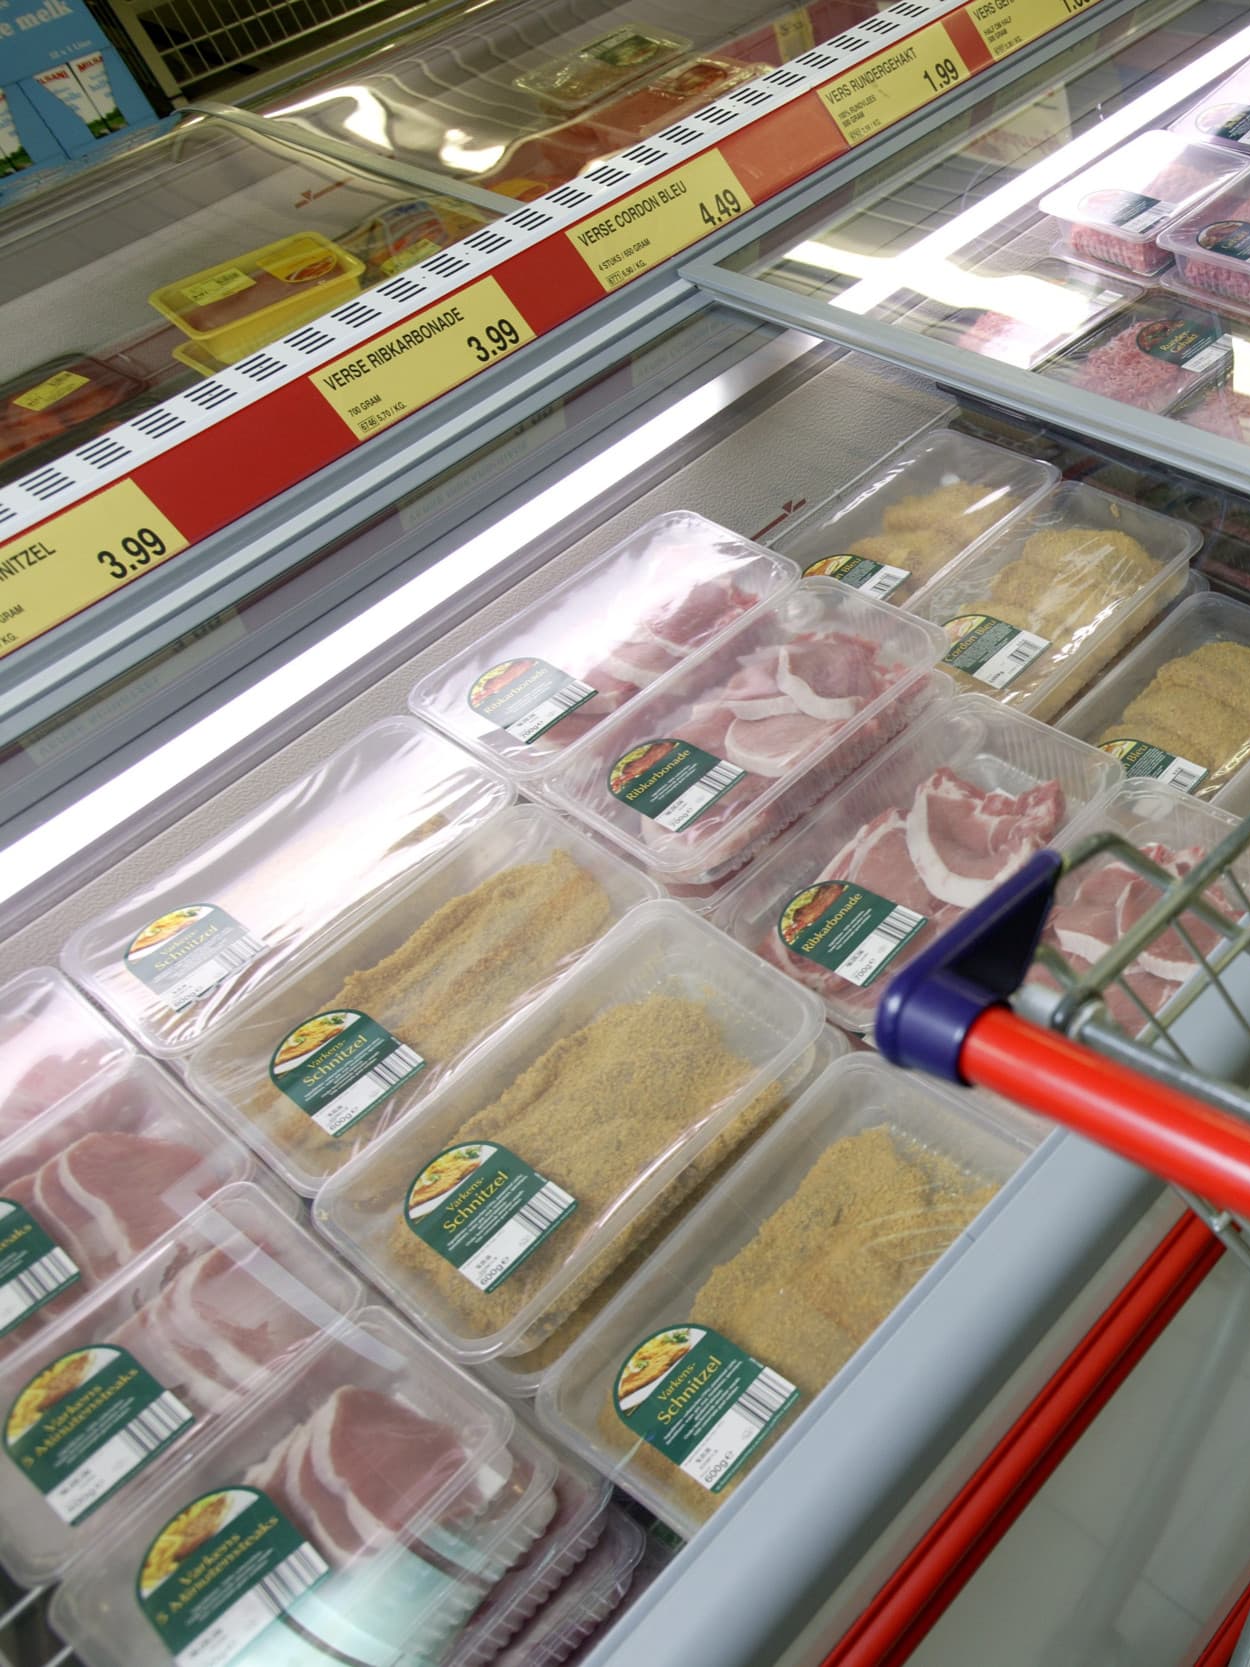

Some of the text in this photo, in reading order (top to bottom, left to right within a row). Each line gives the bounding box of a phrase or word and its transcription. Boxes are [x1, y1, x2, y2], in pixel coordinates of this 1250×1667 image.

[16, 0, 73, 31] melk
[973, 4, 996, 21] VERS
[825, 46, 918, 105] VERS RUNDERGEHAKT
[923, 58, 959, 93] 1.99
[577, 180, 688, 247] VERSE CORDON BLEU
[699, 188, 742, 227] 4.49
[603, 253, 622, 270] STUKS
[633, 237, 651, 252] GRAM
[323, 307, 464, 391] VERSE RIBKARBONADE
[467, 318, 520, 363] 3.99
[348, 394, 382, 418] 700 GRAM
[97, 528, 166, 579] 3.99
[945, 635, 978, 662] Cordon
[1128, 743, 1149, 763] Bleu
[625, 749, 692, 801] Ribkarbonade
[801, 893, 863, 952] Ribkarbonade
[303, 1034, 368, 1087] Schnitzel
[308, 1039, 346, 1069] Varkens-
[443, 1170, 509, 1233] Schnitzel
[446, 1177, 485, 1211] Varkens-
[657, 1362, 696, 1401] Varkens-
[657, 1355, 722, 1425] Schnitzel
[705, 1459, 727, 1483] 600g
